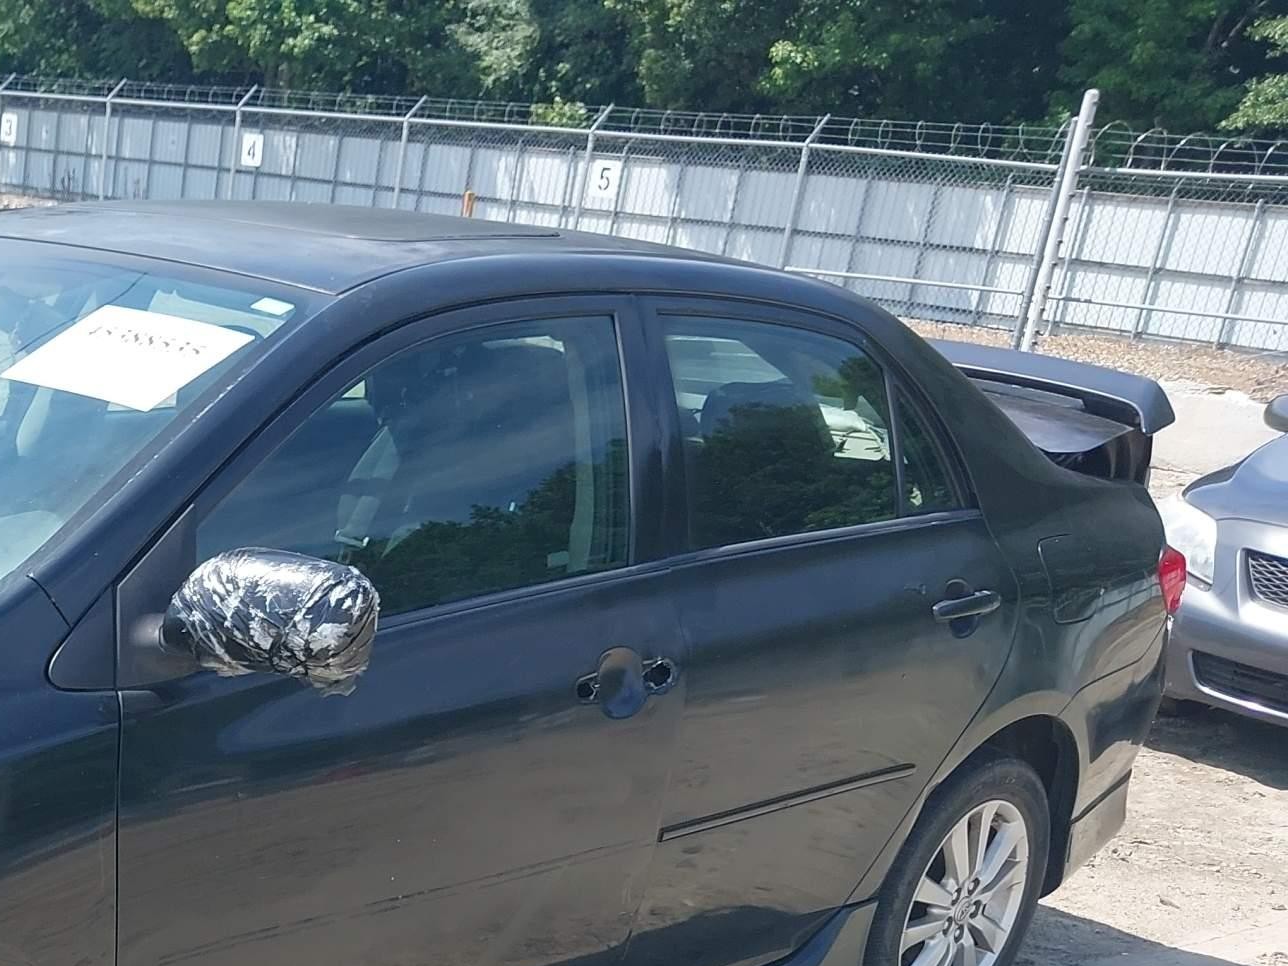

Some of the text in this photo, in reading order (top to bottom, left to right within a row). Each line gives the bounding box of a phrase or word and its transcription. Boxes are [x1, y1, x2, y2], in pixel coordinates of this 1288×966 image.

[4, 119, 13, 137] 3
[247, 140, 257, 160] 4
[598, 167, 611, 190] 5
